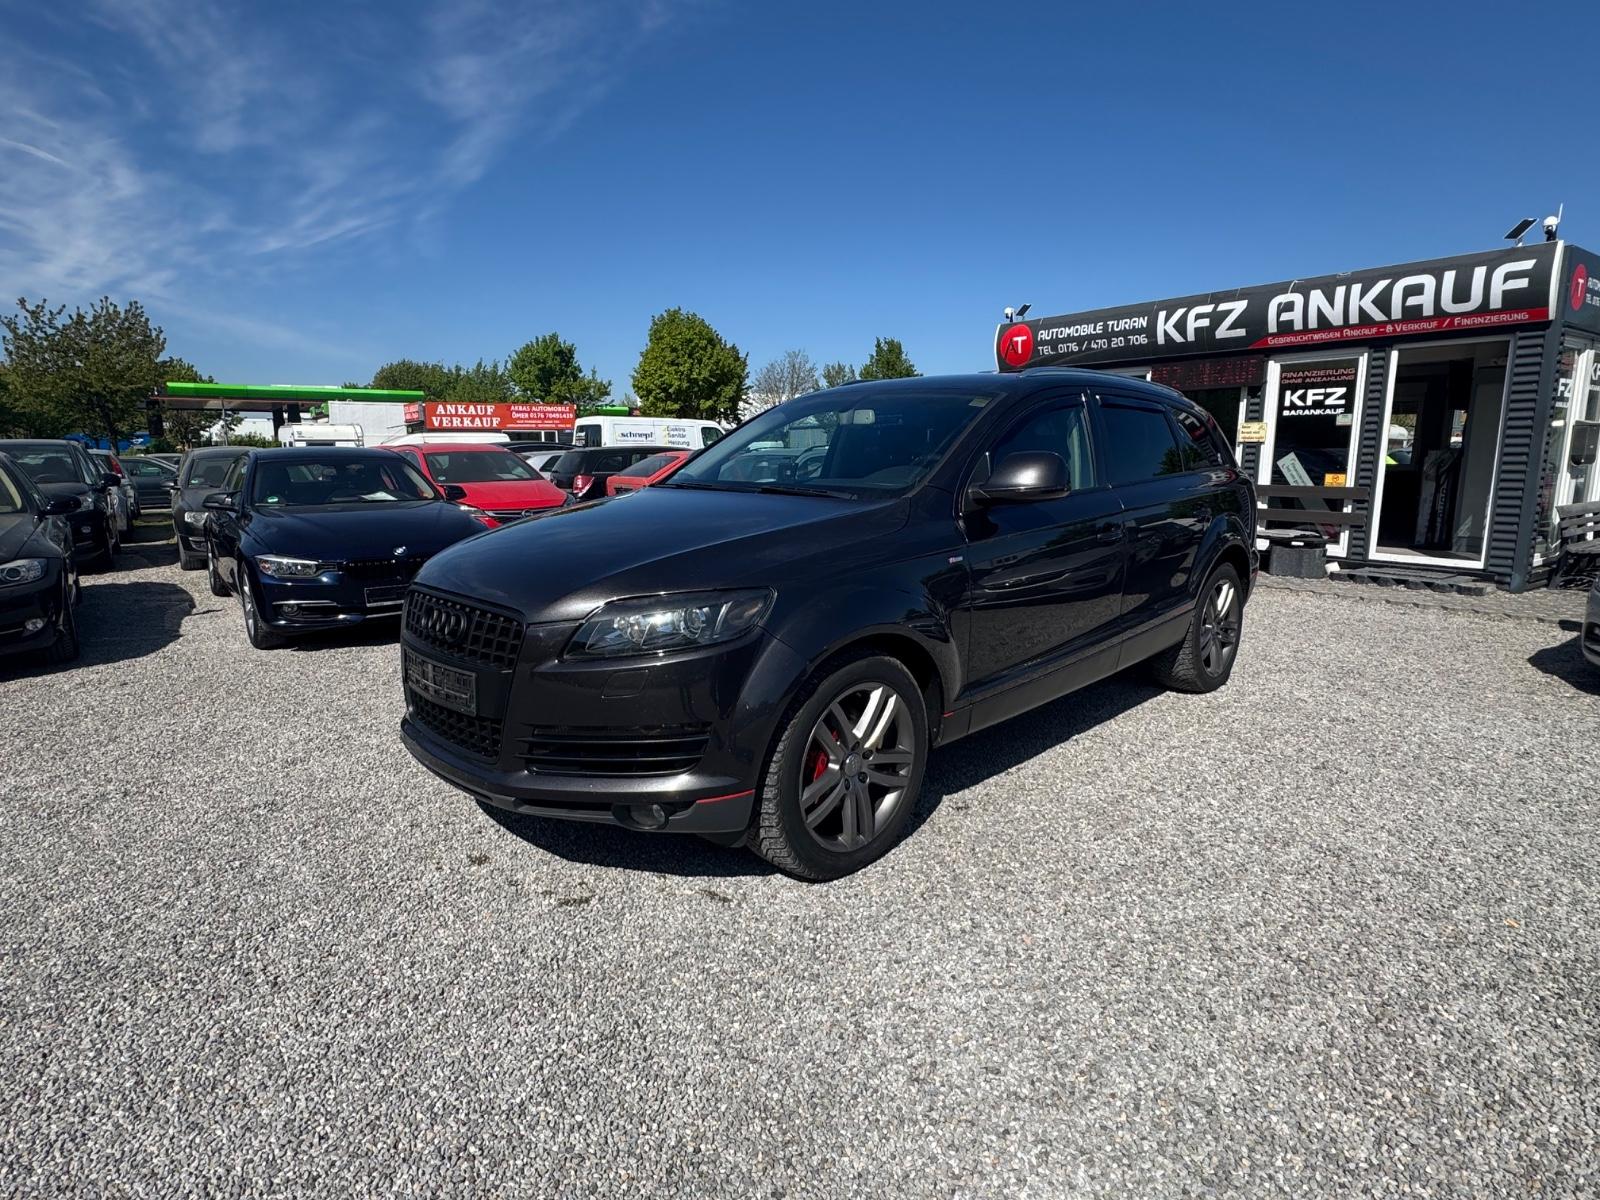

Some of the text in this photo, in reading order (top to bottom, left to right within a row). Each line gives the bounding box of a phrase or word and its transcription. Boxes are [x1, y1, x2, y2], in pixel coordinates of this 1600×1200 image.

[1156, 258, 1538, 345] KFZ ANKAUF
[1037, 315, 1148, 341] AUTOMOBILE TURAN
[1343, 327, 1378, 337] ANKAUF
[1395, 320, 1438, 332] VERKAUF
[1454, 312, 1529, 327] FINANZIERUNG
[1037, 345, 1056, 356] TEL.
[1058, 342, 1079, 353] 0176
[1091, 338, 1108, 349] 470
[1111, 337, 1124, 348] 20
[1127, 334, 1148, 346] 706
[1281, 367, 1356, 379] FINANZIERUNG
[1305, 374, 1355, 383] ANZAHLUNG
[1284, 387, 1347, 407] KFZ
[435, 404, 496, 415] ANKAUF
[1282, 407, 1345, 416] BARANKAUF
[431, 416, 501, 428] VERKAUF
